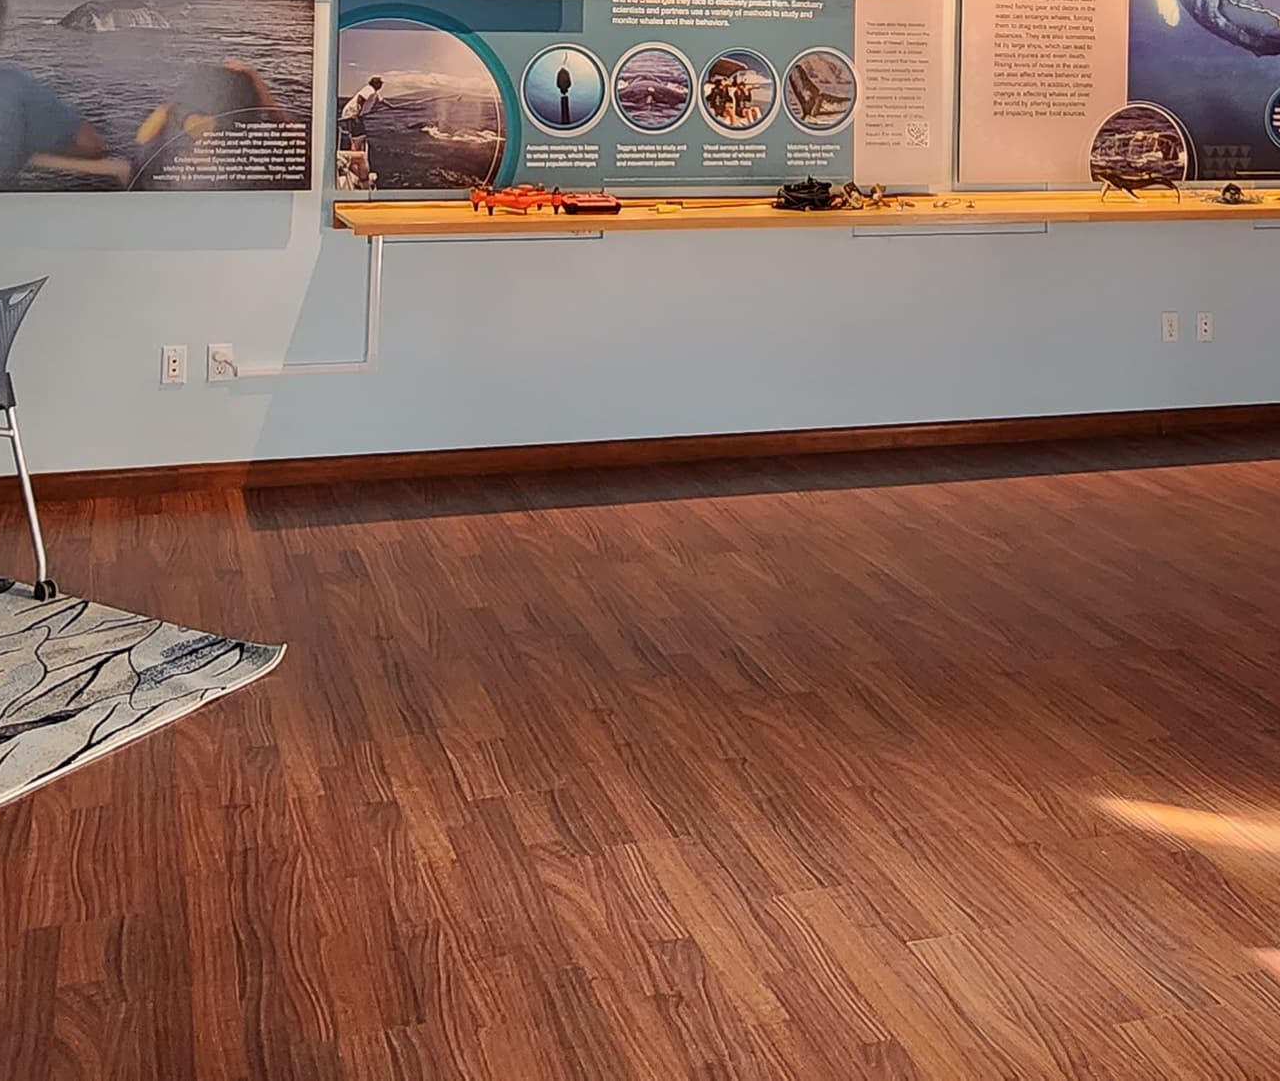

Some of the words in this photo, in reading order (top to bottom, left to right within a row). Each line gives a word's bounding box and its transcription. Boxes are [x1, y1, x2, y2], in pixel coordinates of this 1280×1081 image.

[612, 16, 638, 24] monitor
[640, 16, 663, 25] whales
[665, 17, 677, 25] and
